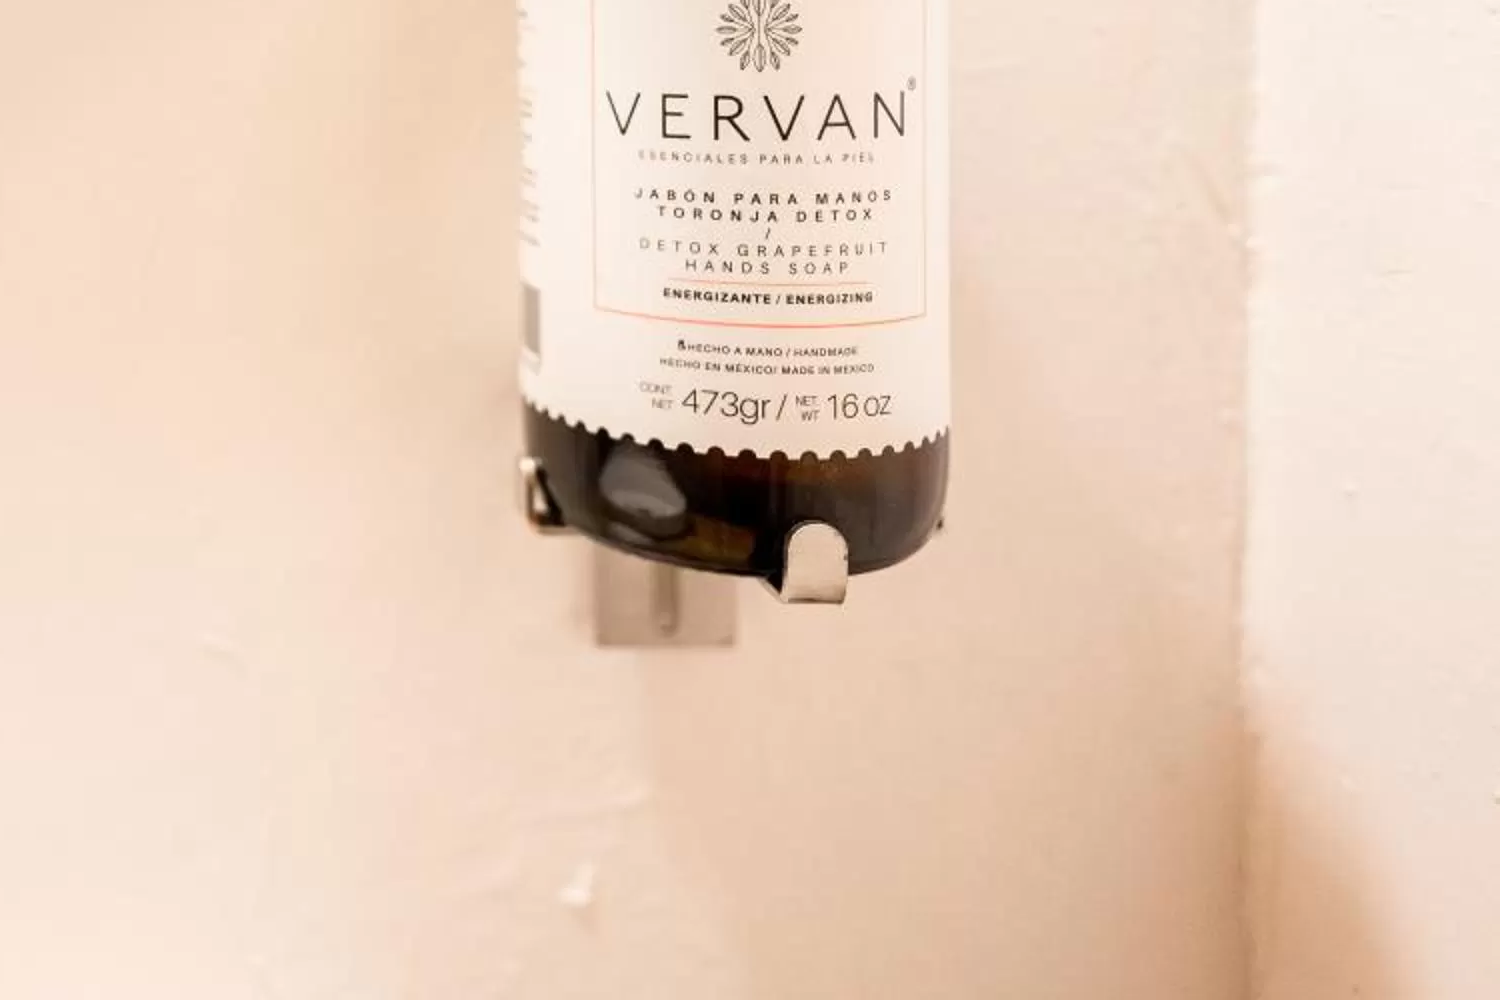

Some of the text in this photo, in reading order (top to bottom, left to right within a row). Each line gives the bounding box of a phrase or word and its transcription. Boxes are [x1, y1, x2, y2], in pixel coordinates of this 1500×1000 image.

[605, 90, 906, 142] VERVAN
[637, 149, 876, 165] ESENCIALES PARA LA PIEL
[633, 187, 893, 206] JABÓN PARA MANOS
[656, 205, 874, 223] TORONJA DETOX
[638, 237, 889, 258] DETOX GRAPEFRUIT
[684, 259, 850, 275] HANDS SOAP
[662, 286, 773, 305] ENERGIZANTE
[785, 291, 875, 305] ENERGIZING
[687, 343, 732, 356] HECHO
[733, 346, 743, 356] A
[745, 346, 783, 357] MANO
[793, 345, 859, 358] HANDMADE
[659, 356, 702, 370] HECHO
[704, 361, 722, 372] EN
[781, 365, 815, 376] MADE
[817, 365, 831, 375] IN
[681, 388, 771, 426] 473gr
[826, 393, 859, 420] 16
